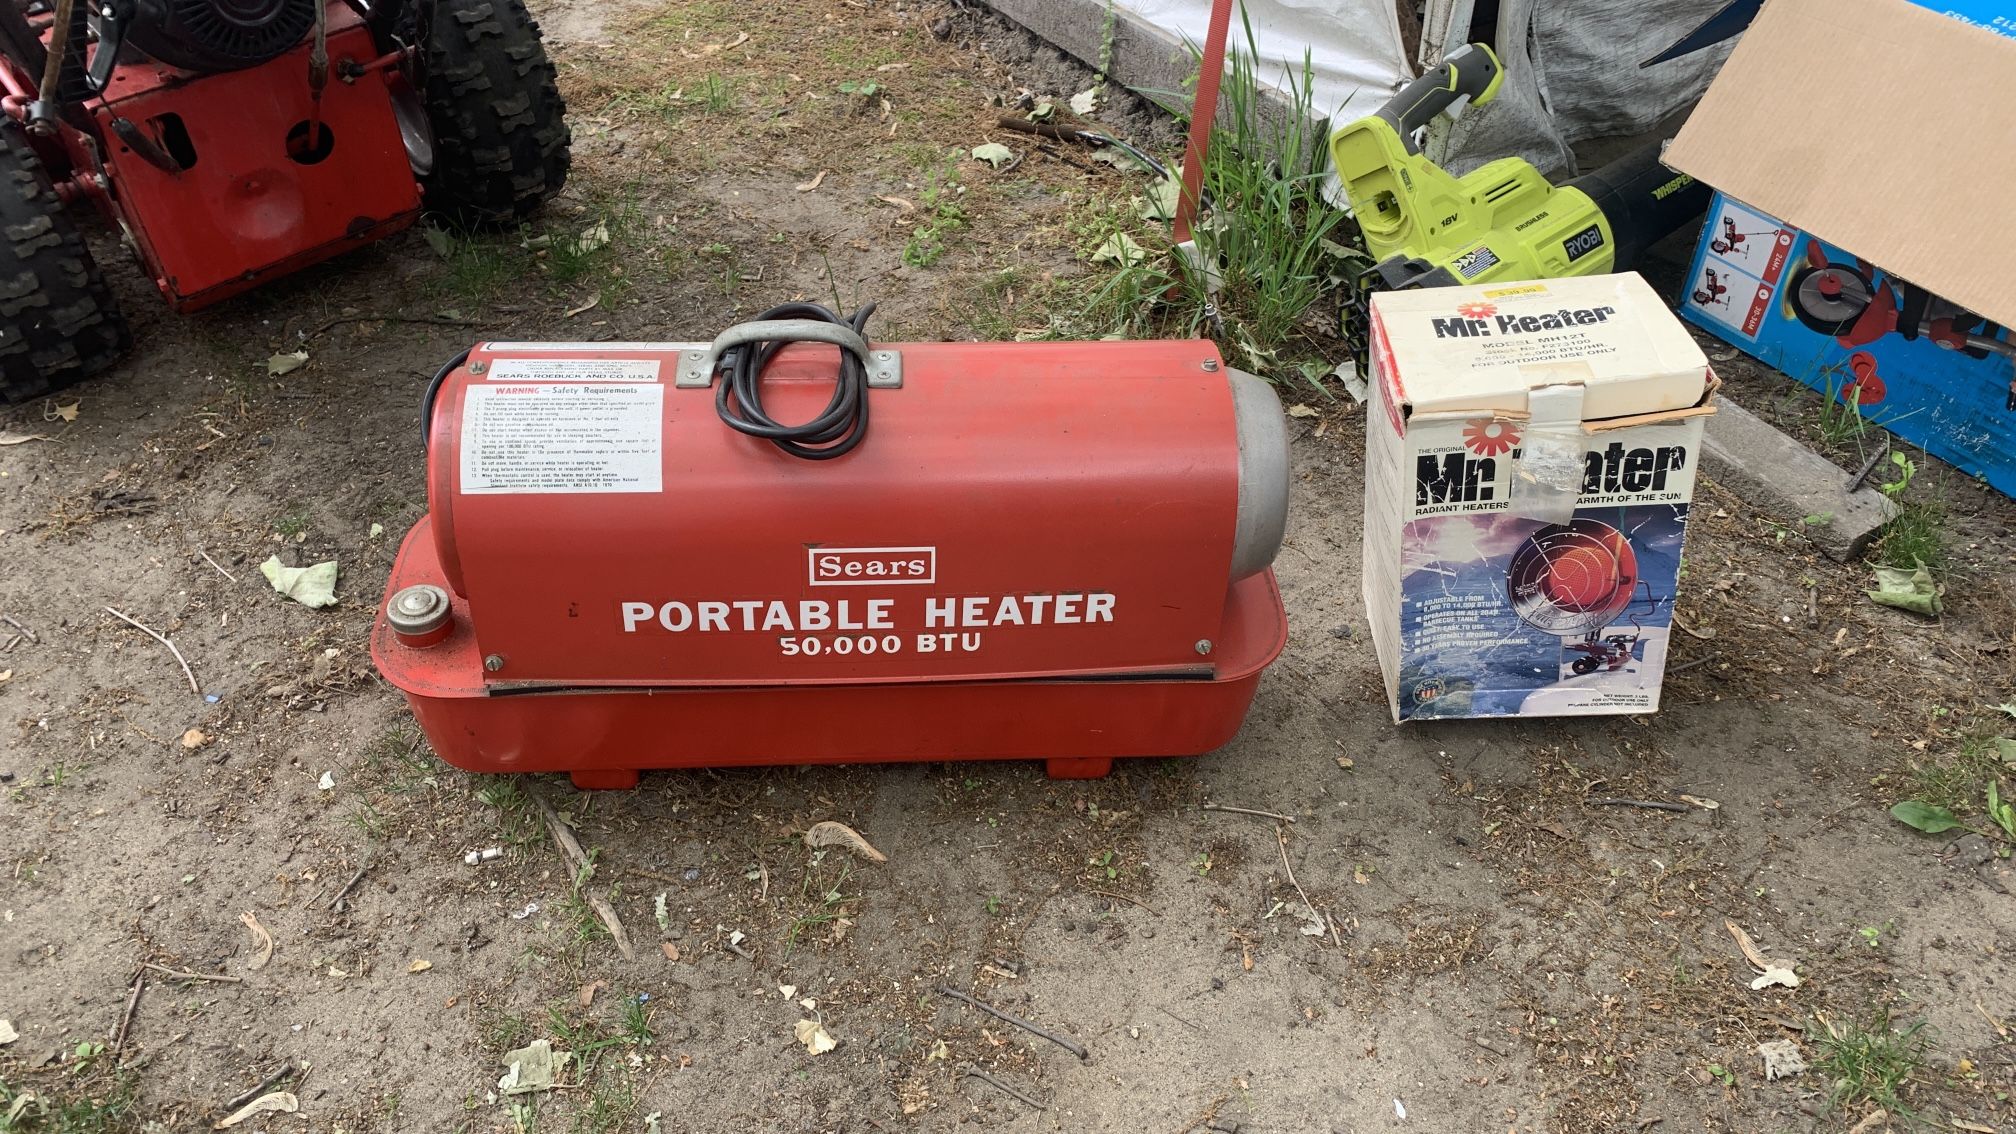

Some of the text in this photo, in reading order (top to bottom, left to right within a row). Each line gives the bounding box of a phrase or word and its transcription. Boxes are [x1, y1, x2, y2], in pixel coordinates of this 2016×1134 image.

[1441, 213, 1458, 228] 18V
[1515, 211, 1549, 232] BRUSHLESS
[1566, 229, 1603, 258] RYOBI
[1431, 305, 1615, 338] Mr. Heater
[1482, 339, 1533, 349] MODEL
[1502, 355, 1556, 365] OUTDOOR
[1587, 347, 1617, 356] ONLY
[496, 387, 540, 395] WARNING
[551, 386, 579, 395] Safety
[583, 386, 638, 395] Requirements
[1433, 446, 1467, 455] ORIGINAL
[1416, 452, 1496, 507] Mr.
[1415, 492, 1682, 516] RADIANT HEATERS ARMTH OF THE SUN
[819, 555, 927, 578] Sears
[1423, 596, 1463, 606] ADJUSTABLE
[621, 592, 1117, 633] PORTABLE HEATER
[780, 632, 983, 657] 50,000 BTU
